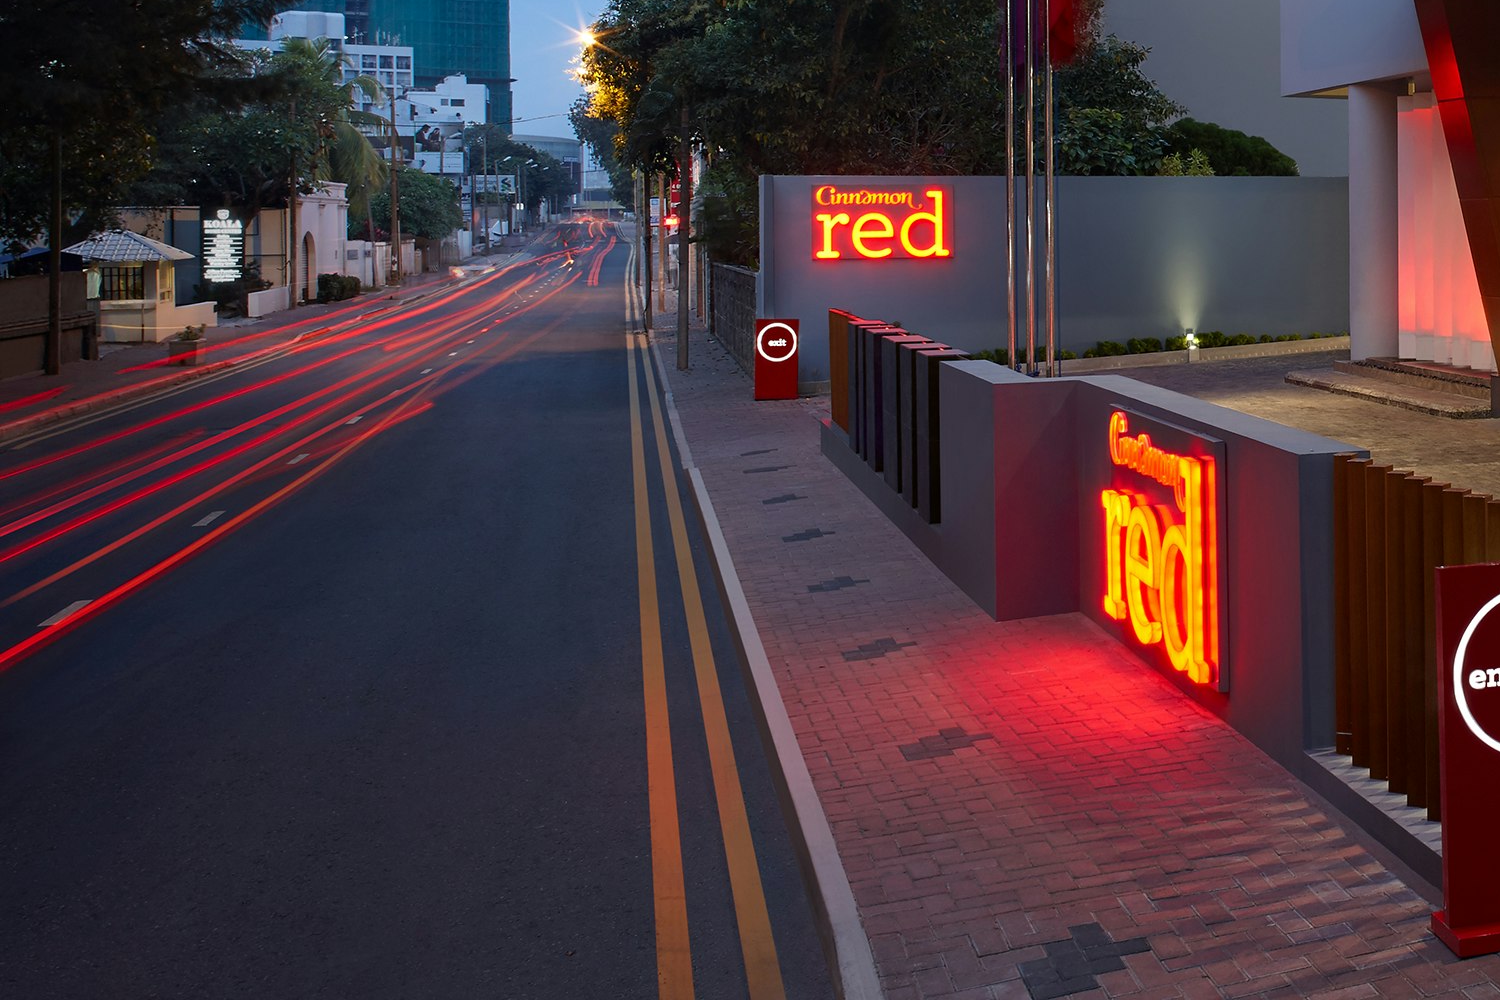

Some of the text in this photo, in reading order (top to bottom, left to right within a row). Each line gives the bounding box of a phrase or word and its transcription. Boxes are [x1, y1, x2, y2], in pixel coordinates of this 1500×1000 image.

[815, 185, 923, 210] Cinnamon
[203, 220, 242, 228] KOALA
[815, 190, 950, 259] red
[1101, 455, 1217, 684] red
